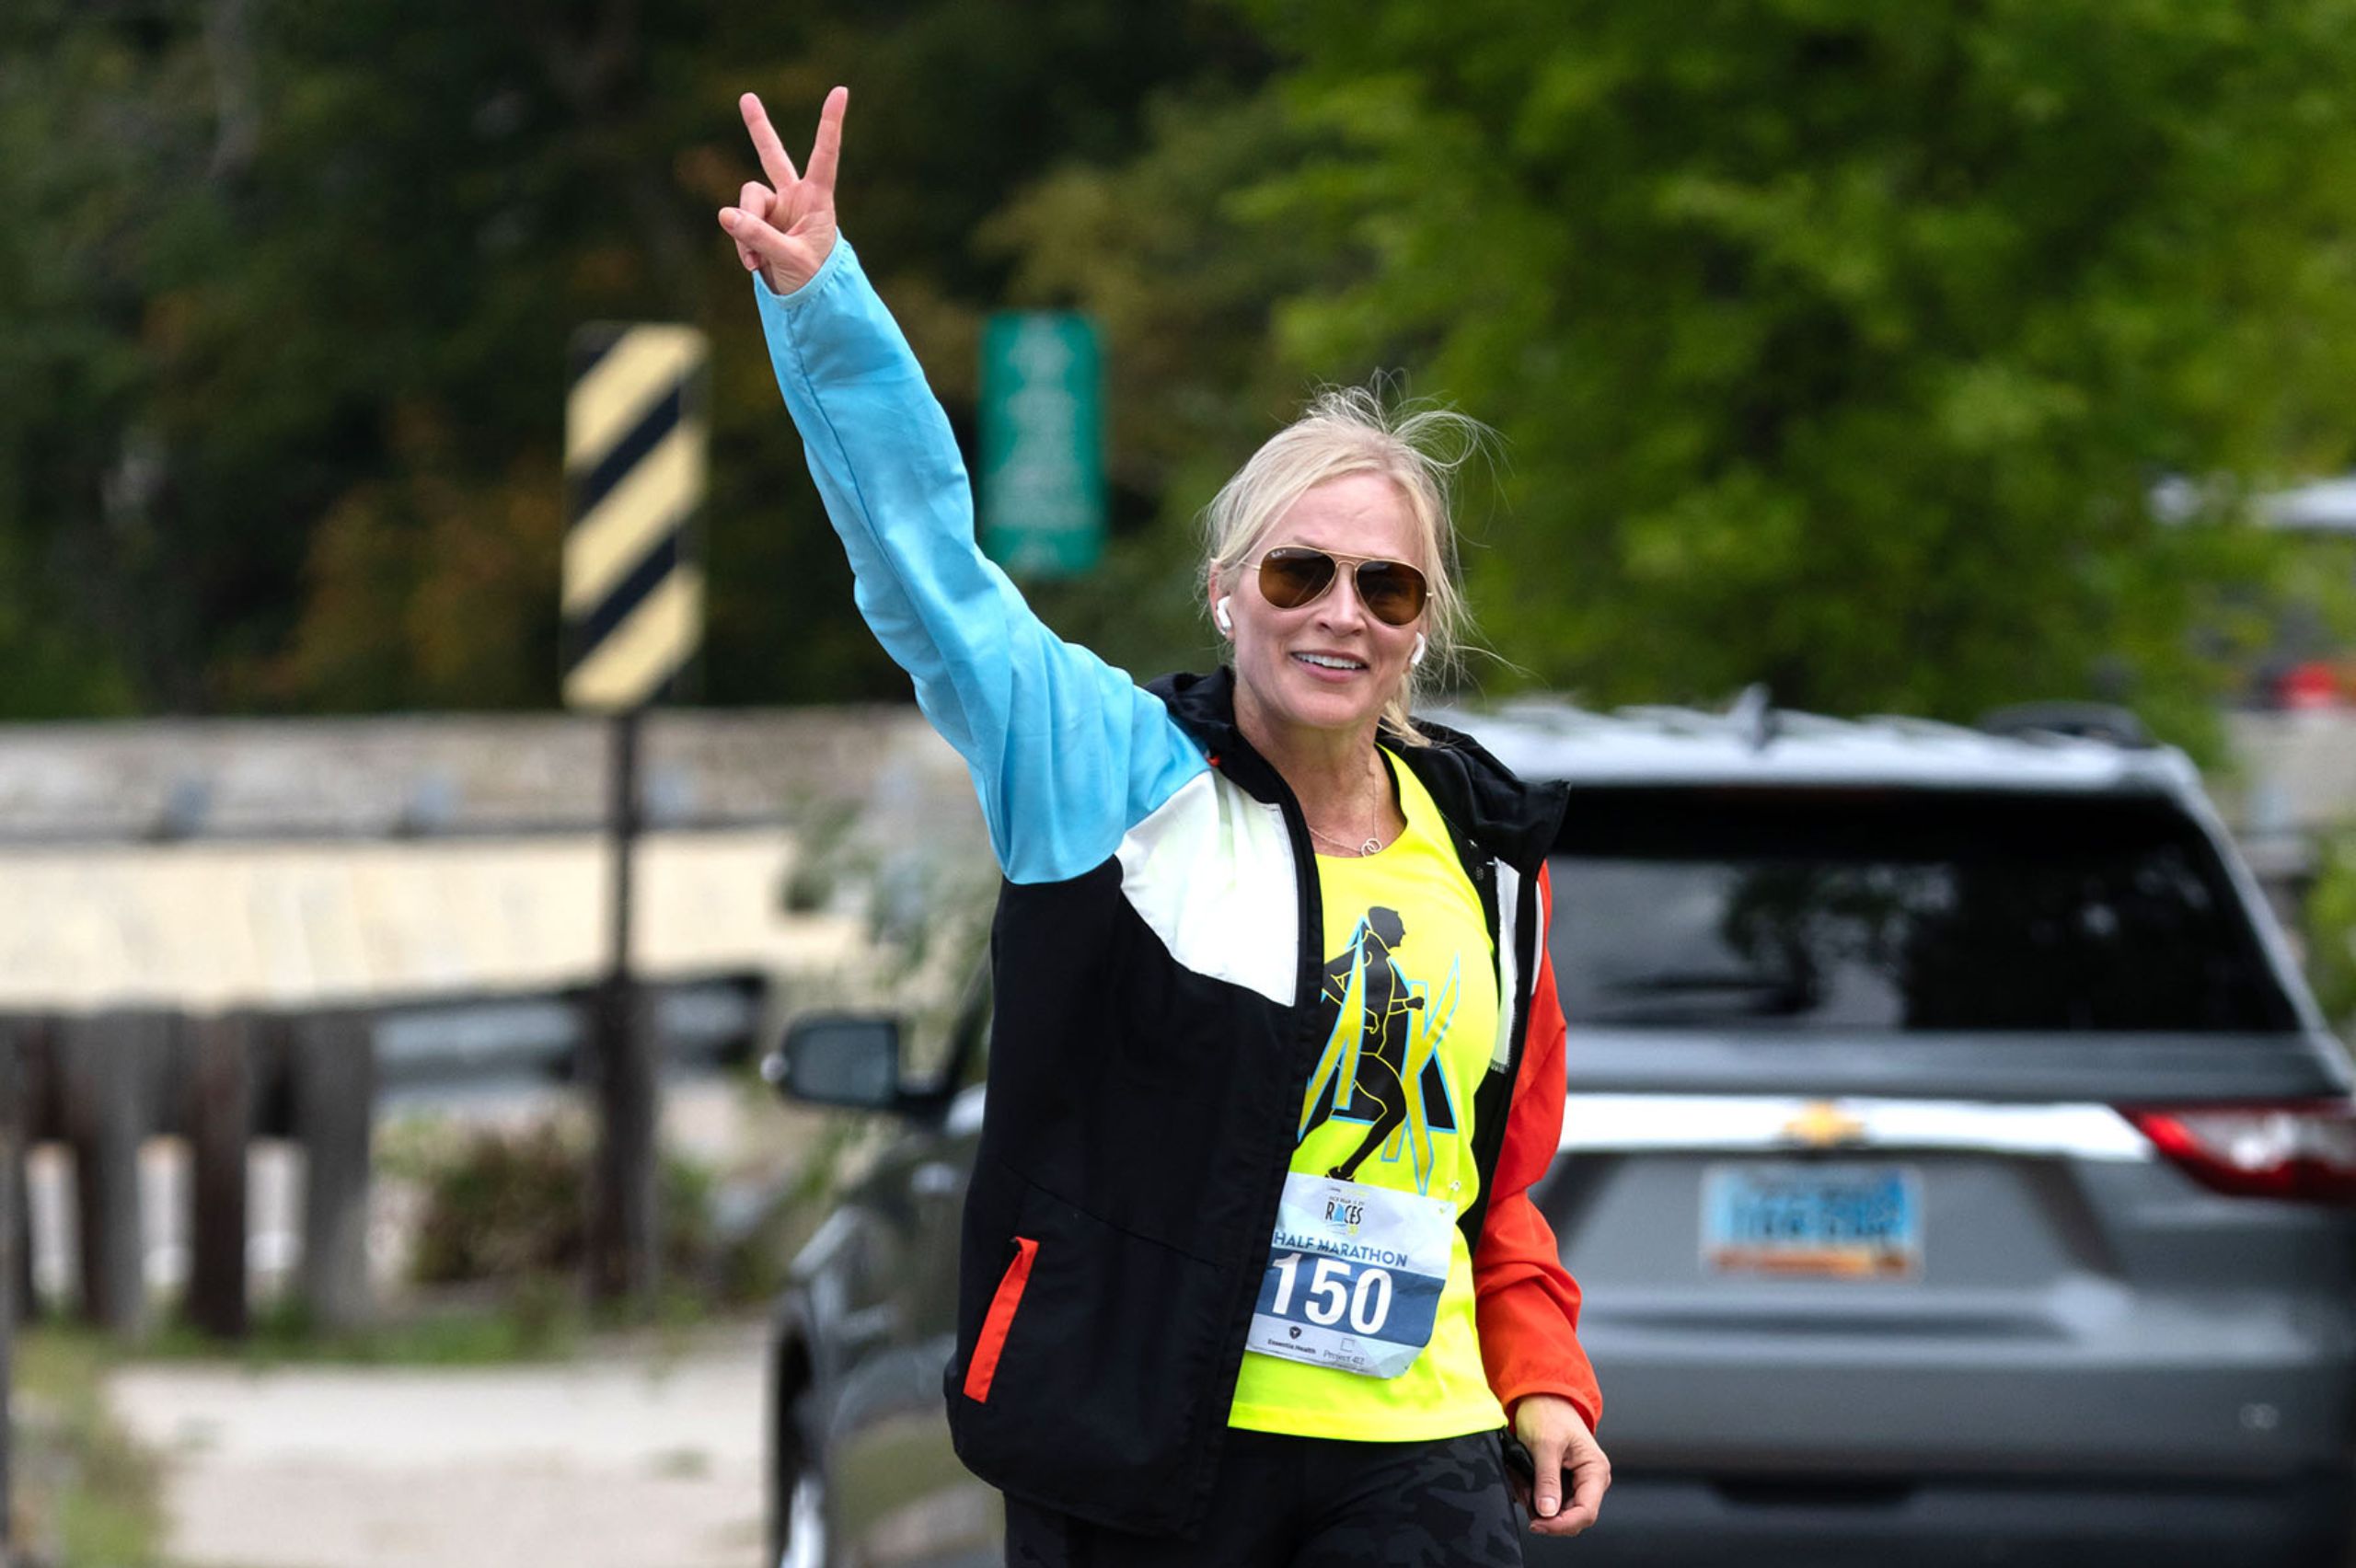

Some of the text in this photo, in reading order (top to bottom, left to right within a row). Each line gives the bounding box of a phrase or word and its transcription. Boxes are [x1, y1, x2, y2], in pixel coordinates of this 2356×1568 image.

[1325, 1201, 1363, 1225] RACES
[1274, 1231, 1408, 1267] HALF MARATHON
[1271, 1252, 1392, 1334] 150
